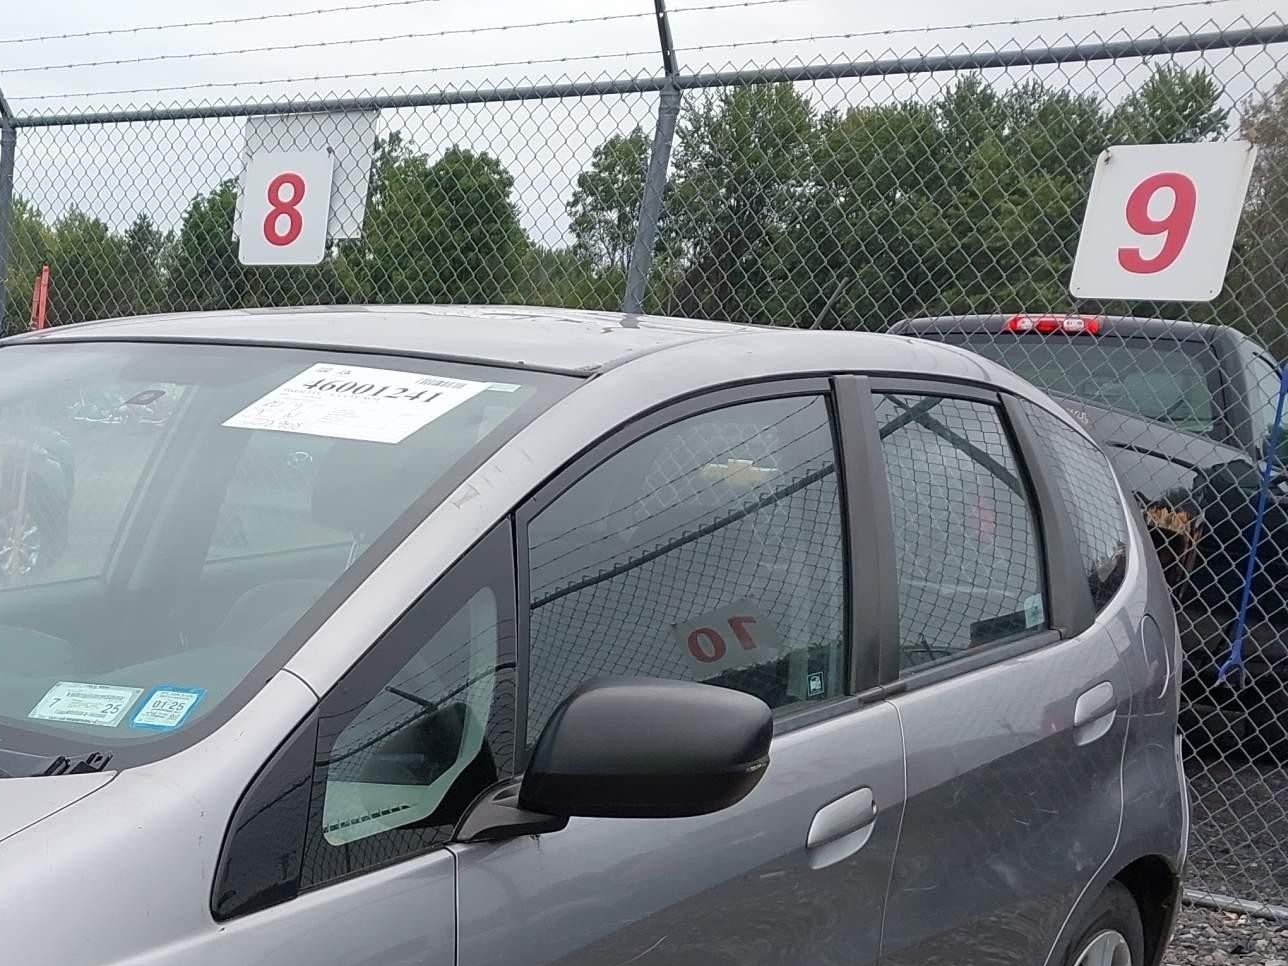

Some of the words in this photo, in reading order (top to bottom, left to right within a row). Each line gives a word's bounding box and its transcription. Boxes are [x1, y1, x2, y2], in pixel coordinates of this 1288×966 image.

[263, 172, 306, 247] 8
[1117, 172, 1197, 275] 9
[303, 378, 444, 403] 46001241
[100, 703, 123, 715] 25
